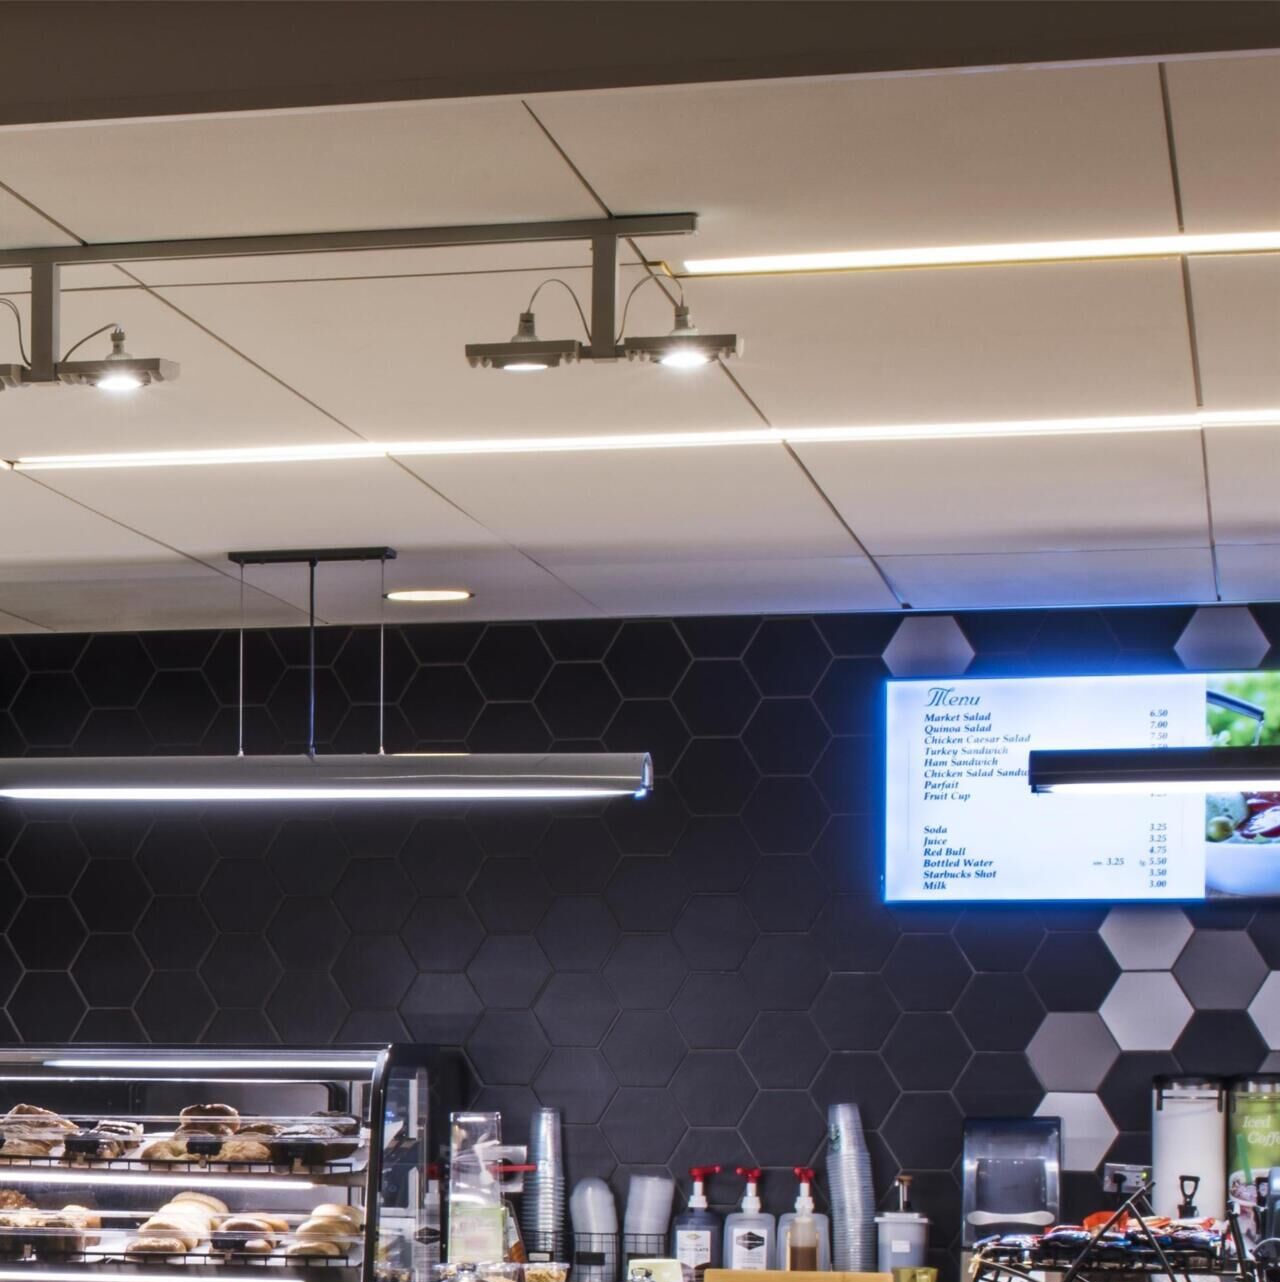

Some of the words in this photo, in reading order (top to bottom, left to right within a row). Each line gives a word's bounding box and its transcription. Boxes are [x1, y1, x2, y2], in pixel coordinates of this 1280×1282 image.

[924, 687, 981, 707] Menu
[924, 713, 960, 722] Market
[963, 712, 991, 721] Salad
[924, 724, 961, 734] Quinoa
[964, 723, 992, 733] Salad
[924, 735, 963, 745] Chicken
[966, 735, 1000, 743] Caesar
[1003, 734, 1031, 743] Salad
[925, 746, 958, 757] Turkey
[961, 745, 1009, 755] Sandwich
[924, 758, 948, 767] Ham
[951, 757, 999, 767] Sandwich
[924, 769, 963, 779] Chicken
[966, 768, 994, 777] Salad
[924, 780, 959, 791] Parfait
[924, 791, 948, 801] Fruit
[951, 792, 971, 802] Cup
[923, 825, 948, 834] Soda
[923, 836, 948, 847] Juice
[923, 847, 942, 856] Red
[945, 847, 966, 856] Bull
[923, 858, 960, 868] Bottled
[963, 859, 994, 867] Water
[923, 869, 972, 879] Starbucks
[974, 869, 997, 878] Shot
[923, 881, 947, 890] Milk
[1242, 1115, 1271, 1129] Iced
